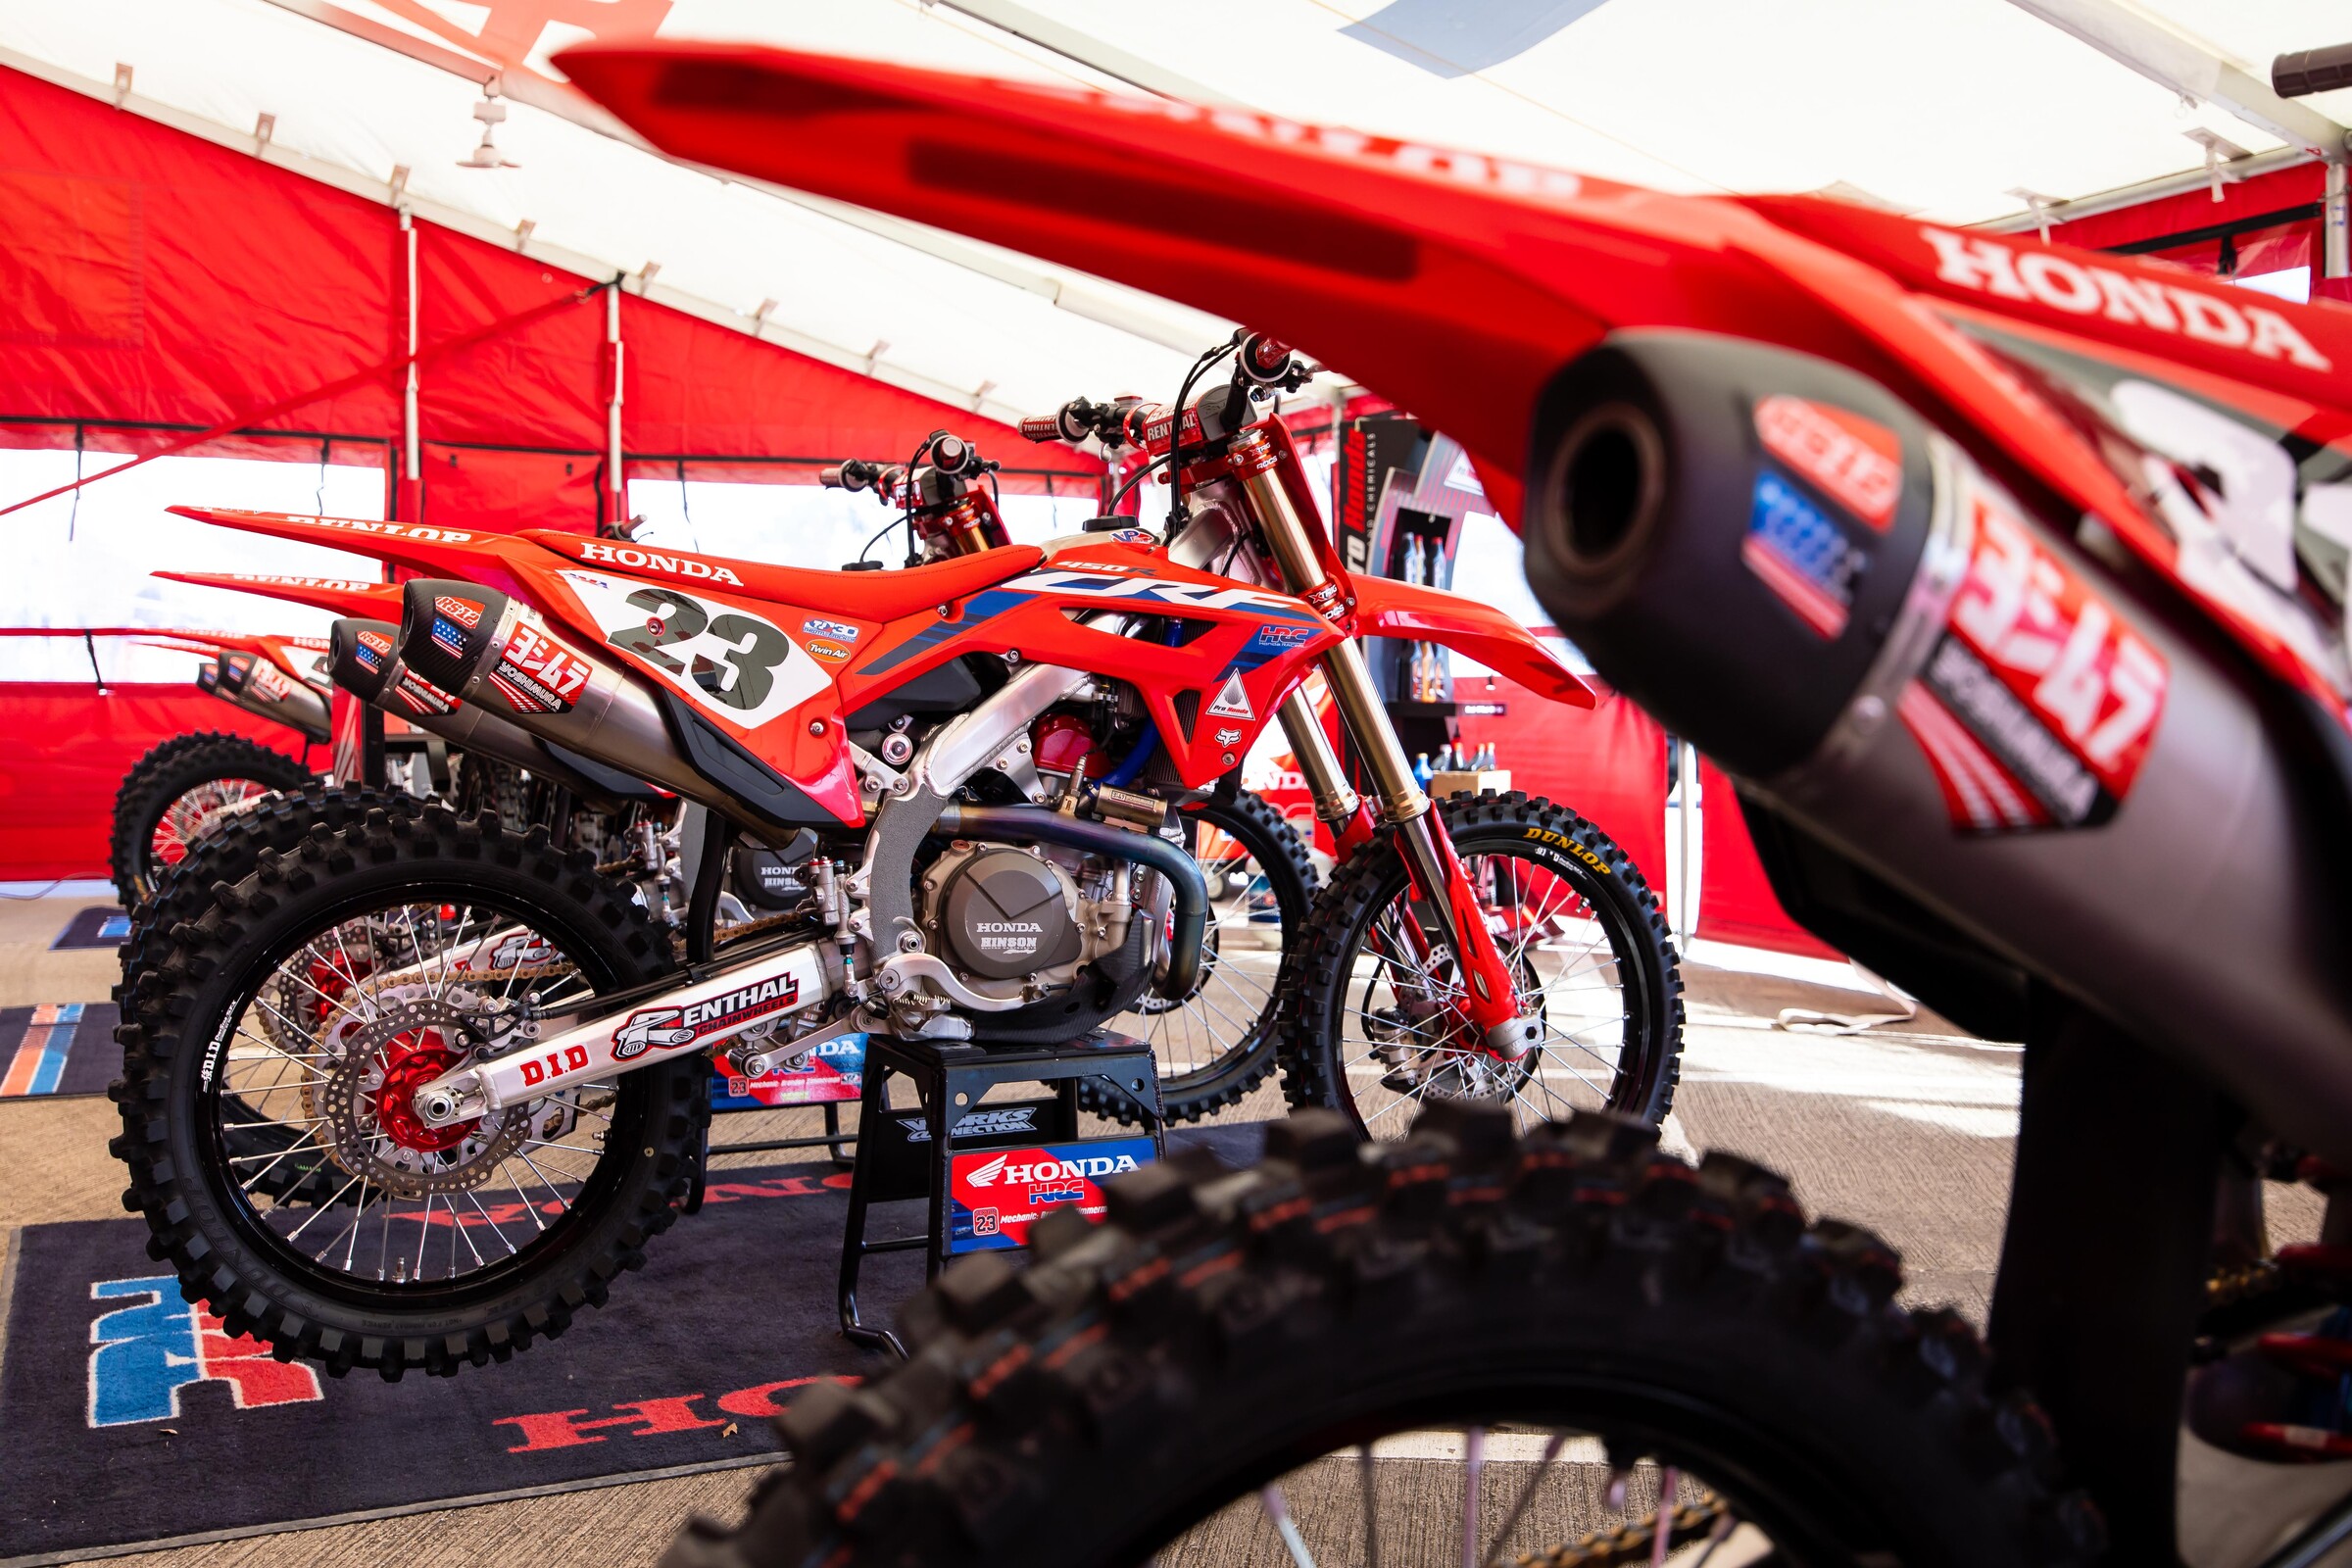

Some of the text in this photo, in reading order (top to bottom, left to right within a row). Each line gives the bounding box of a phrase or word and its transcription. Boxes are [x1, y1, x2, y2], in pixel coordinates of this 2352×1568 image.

[1921, 227, 2331, 371] HONDA
[1148, 413, 1196, 441] RENTAL
[1366, 432, 1376, 512] CHEMICALS
[1344, 428, 1365, 573] ro Honda
[580, 542, 744, 587] HONDA
[1055, 561, 1157, 576] 450R
[1000, 571, 1304, 611] CRF
[1308, 584, 1338, 604] XTRIG
[435, 596, 481, 626] RS12
[358, 631, 392, 654] RS12
[606, 588, 789, 710] 23
[809, 644, 833, 656] Twin
[1259, 626, 1308, 644] HRC
[505, 627, 589, 696] ヨシムラ
[498, 662, 562, 710] YOSHIMURA
[1523, 827, 1611, 874] DUNLOP
[760, 866, 800, 875] HON
[976, 922, 1043, 932] HONDA
[981, 937, 1037, 948] HINSON
[616, 976, 796, 1057] RENTHAL
[699, 995, 795, 1034] CHAINWHEELS
[519, 1045, 589, 1087] D.I.D
[730, 1081, 748, 1094] 23
[902, 1108, 1036, 1131] WRKS
[1004, 1155, 1141, 1185] HONDA
[1029, 1180, 1084, 1204] HRC
[975, 1213, 997, 1234] 23
[1000, 1211, 1040, 1224] Mechanic:
